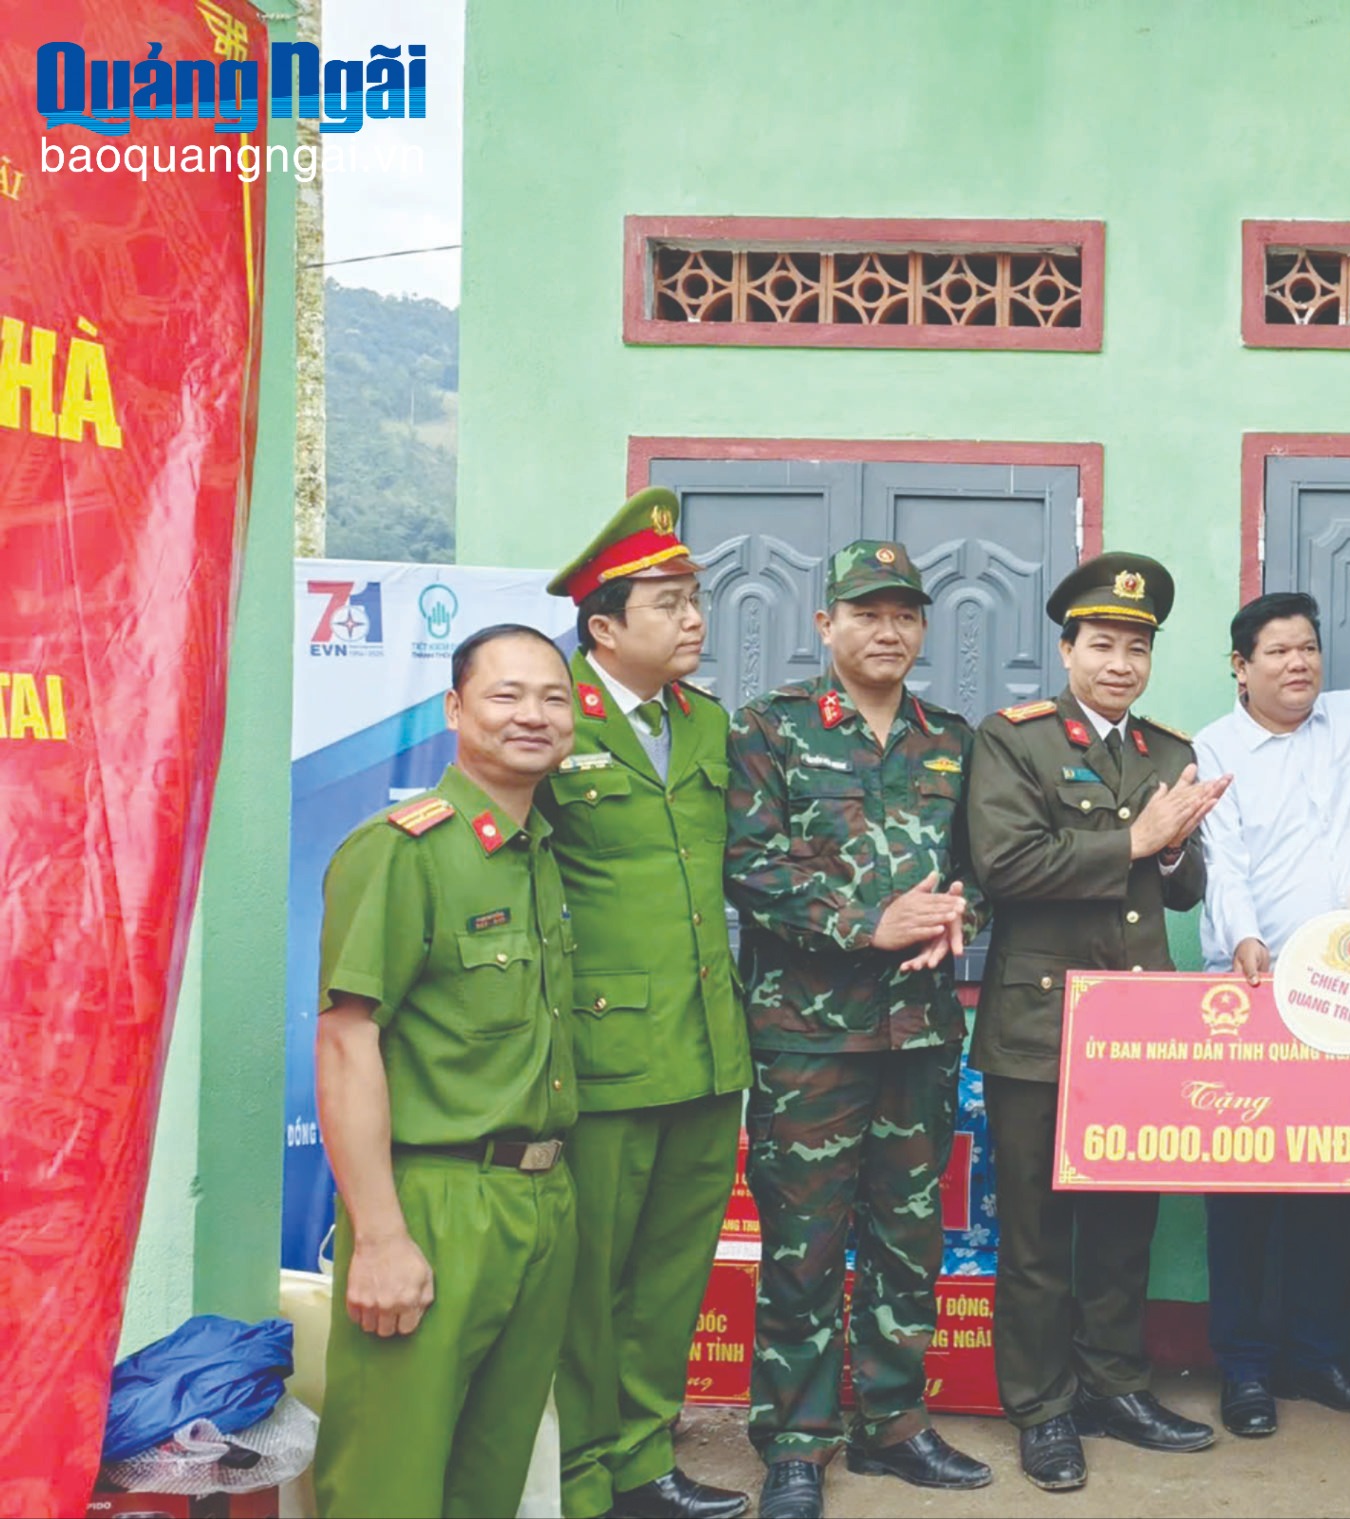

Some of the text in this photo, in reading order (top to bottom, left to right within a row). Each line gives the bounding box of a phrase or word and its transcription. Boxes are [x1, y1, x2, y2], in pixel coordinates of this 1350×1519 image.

[307, 580, 383, 643] 71
[310, 644, 348, 657] EVN
[1287, 988, 1331, 1015] QUANG
[1110, 1041, 1142, 1060] BAN
[1146, 1037, 1189, 1061] NHÂN
[1193, 1037, 1224, 1061] DÂN
[1228, 1038, 1264, 1061] TỈNH
[1180, 1079, 1272, 1123] Tặng
[1083, 1124, 1276, 1163] 60.000.000
[706, 1336, 745, 1362] TỈNH
[953, 1326, 992, 1347] NGÃI
